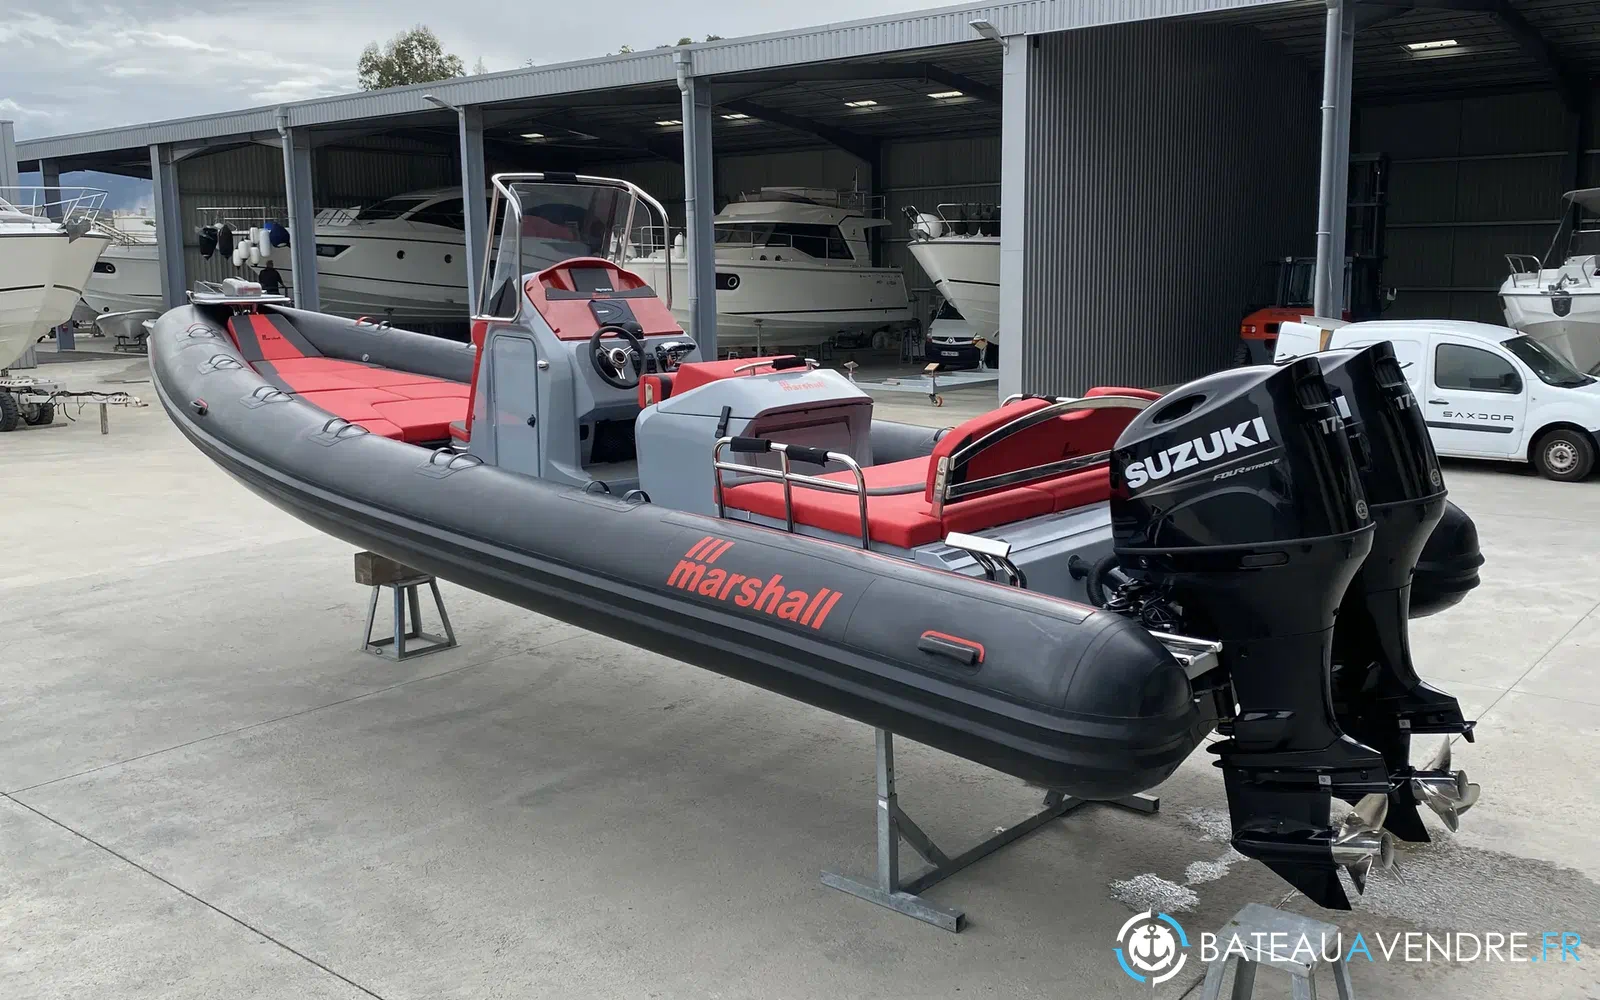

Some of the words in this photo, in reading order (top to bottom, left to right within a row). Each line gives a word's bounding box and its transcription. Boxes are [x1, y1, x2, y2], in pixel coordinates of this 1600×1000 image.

[1442, 410, 1515, 421] SAXDOR
[1124, 416, 1271, 489] SUZUKI
[666, 559, 843, 630] marshall
